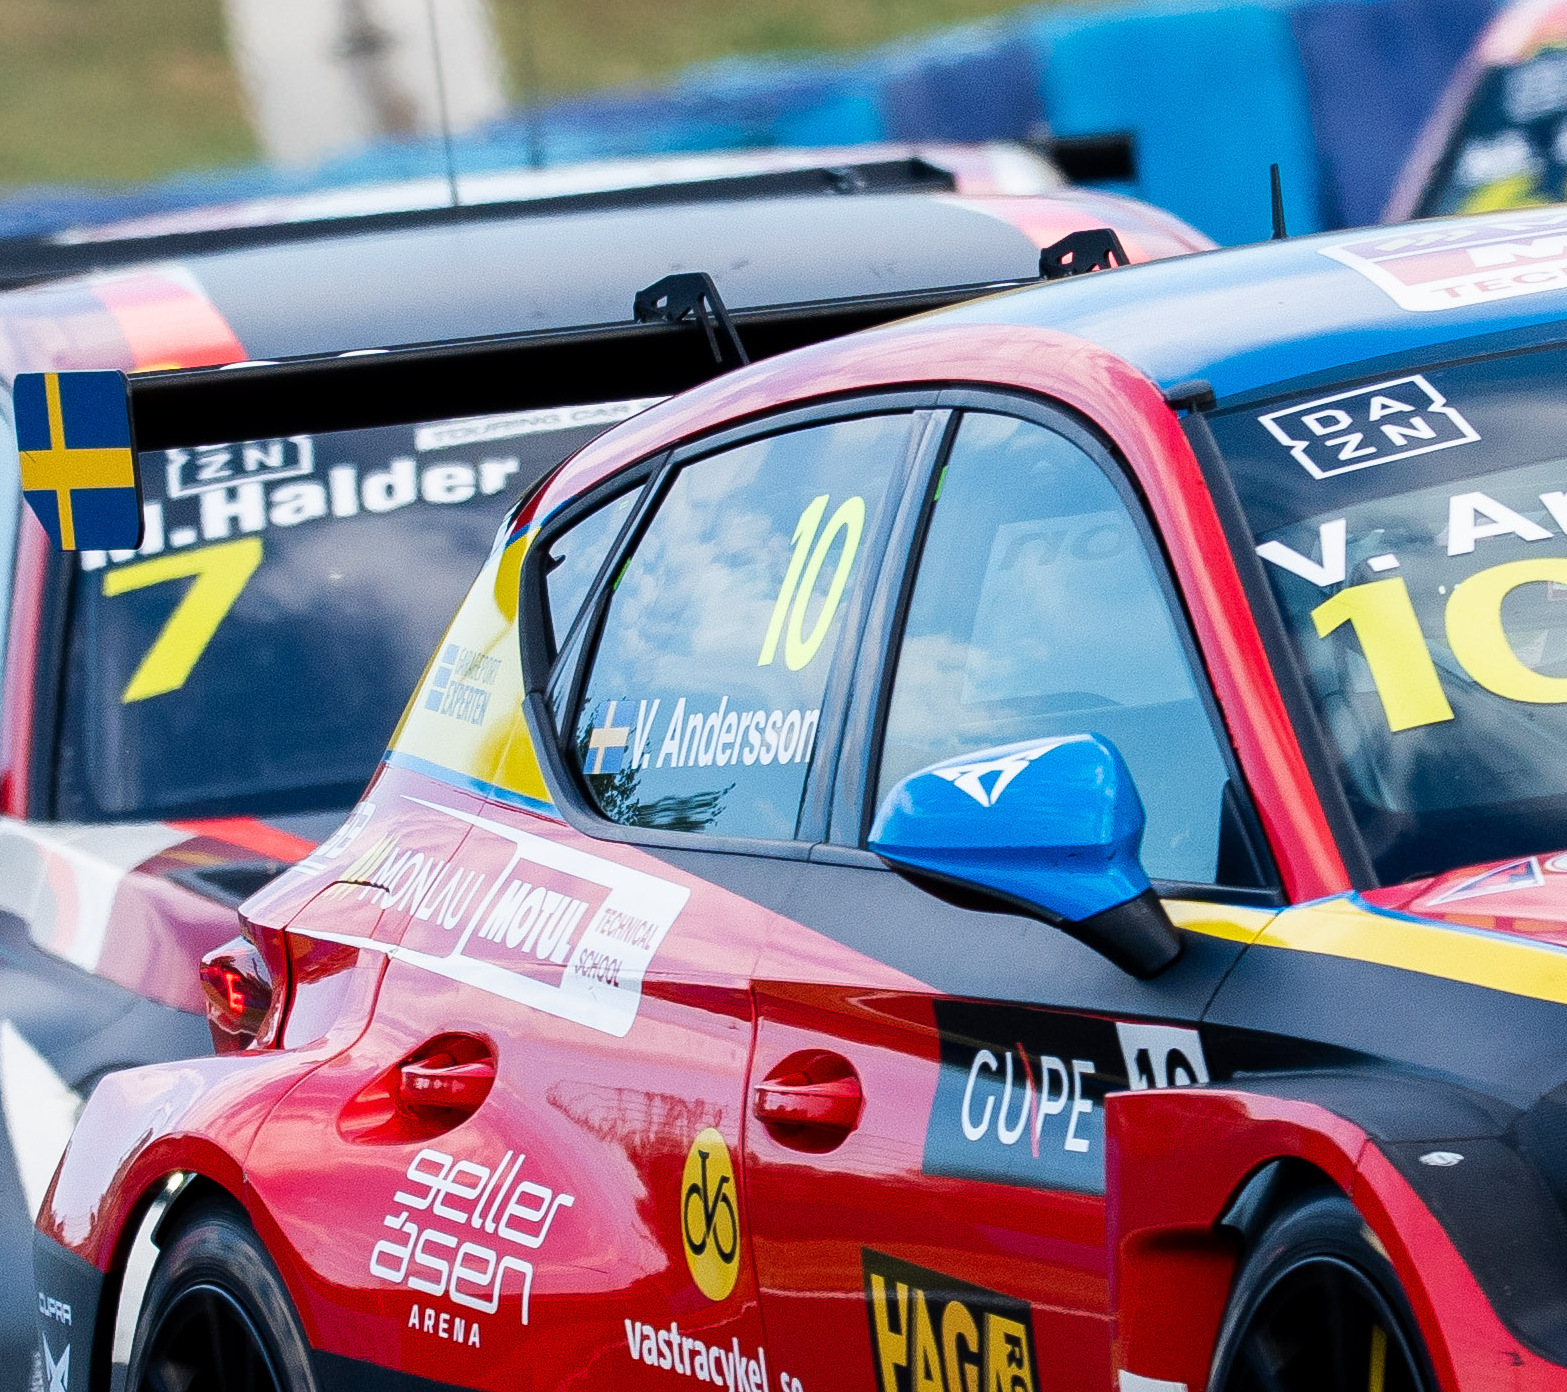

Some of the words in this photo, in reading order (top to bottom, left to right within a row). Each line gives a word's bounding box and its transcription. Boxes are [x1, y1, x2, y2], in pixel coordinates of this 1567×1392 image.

[758, 494, 865, 671] 10
[1256, 518, 1399, 589] V.
[102, 537, 264, 705] 7
[631, 700, 662, 770] V.
[657, 696, 820, 769] Andersson
[358, 847, 485, 930] MONLAU
[481, 879, 590, 963] MOTUL
[594, 908, 658, 951] TECHNICAL
[574, 948, 623, 988] SCHOOL
[39, 1292, 71, 1326] CUPRA
[408, 1304, 481, 1348] ARENA
